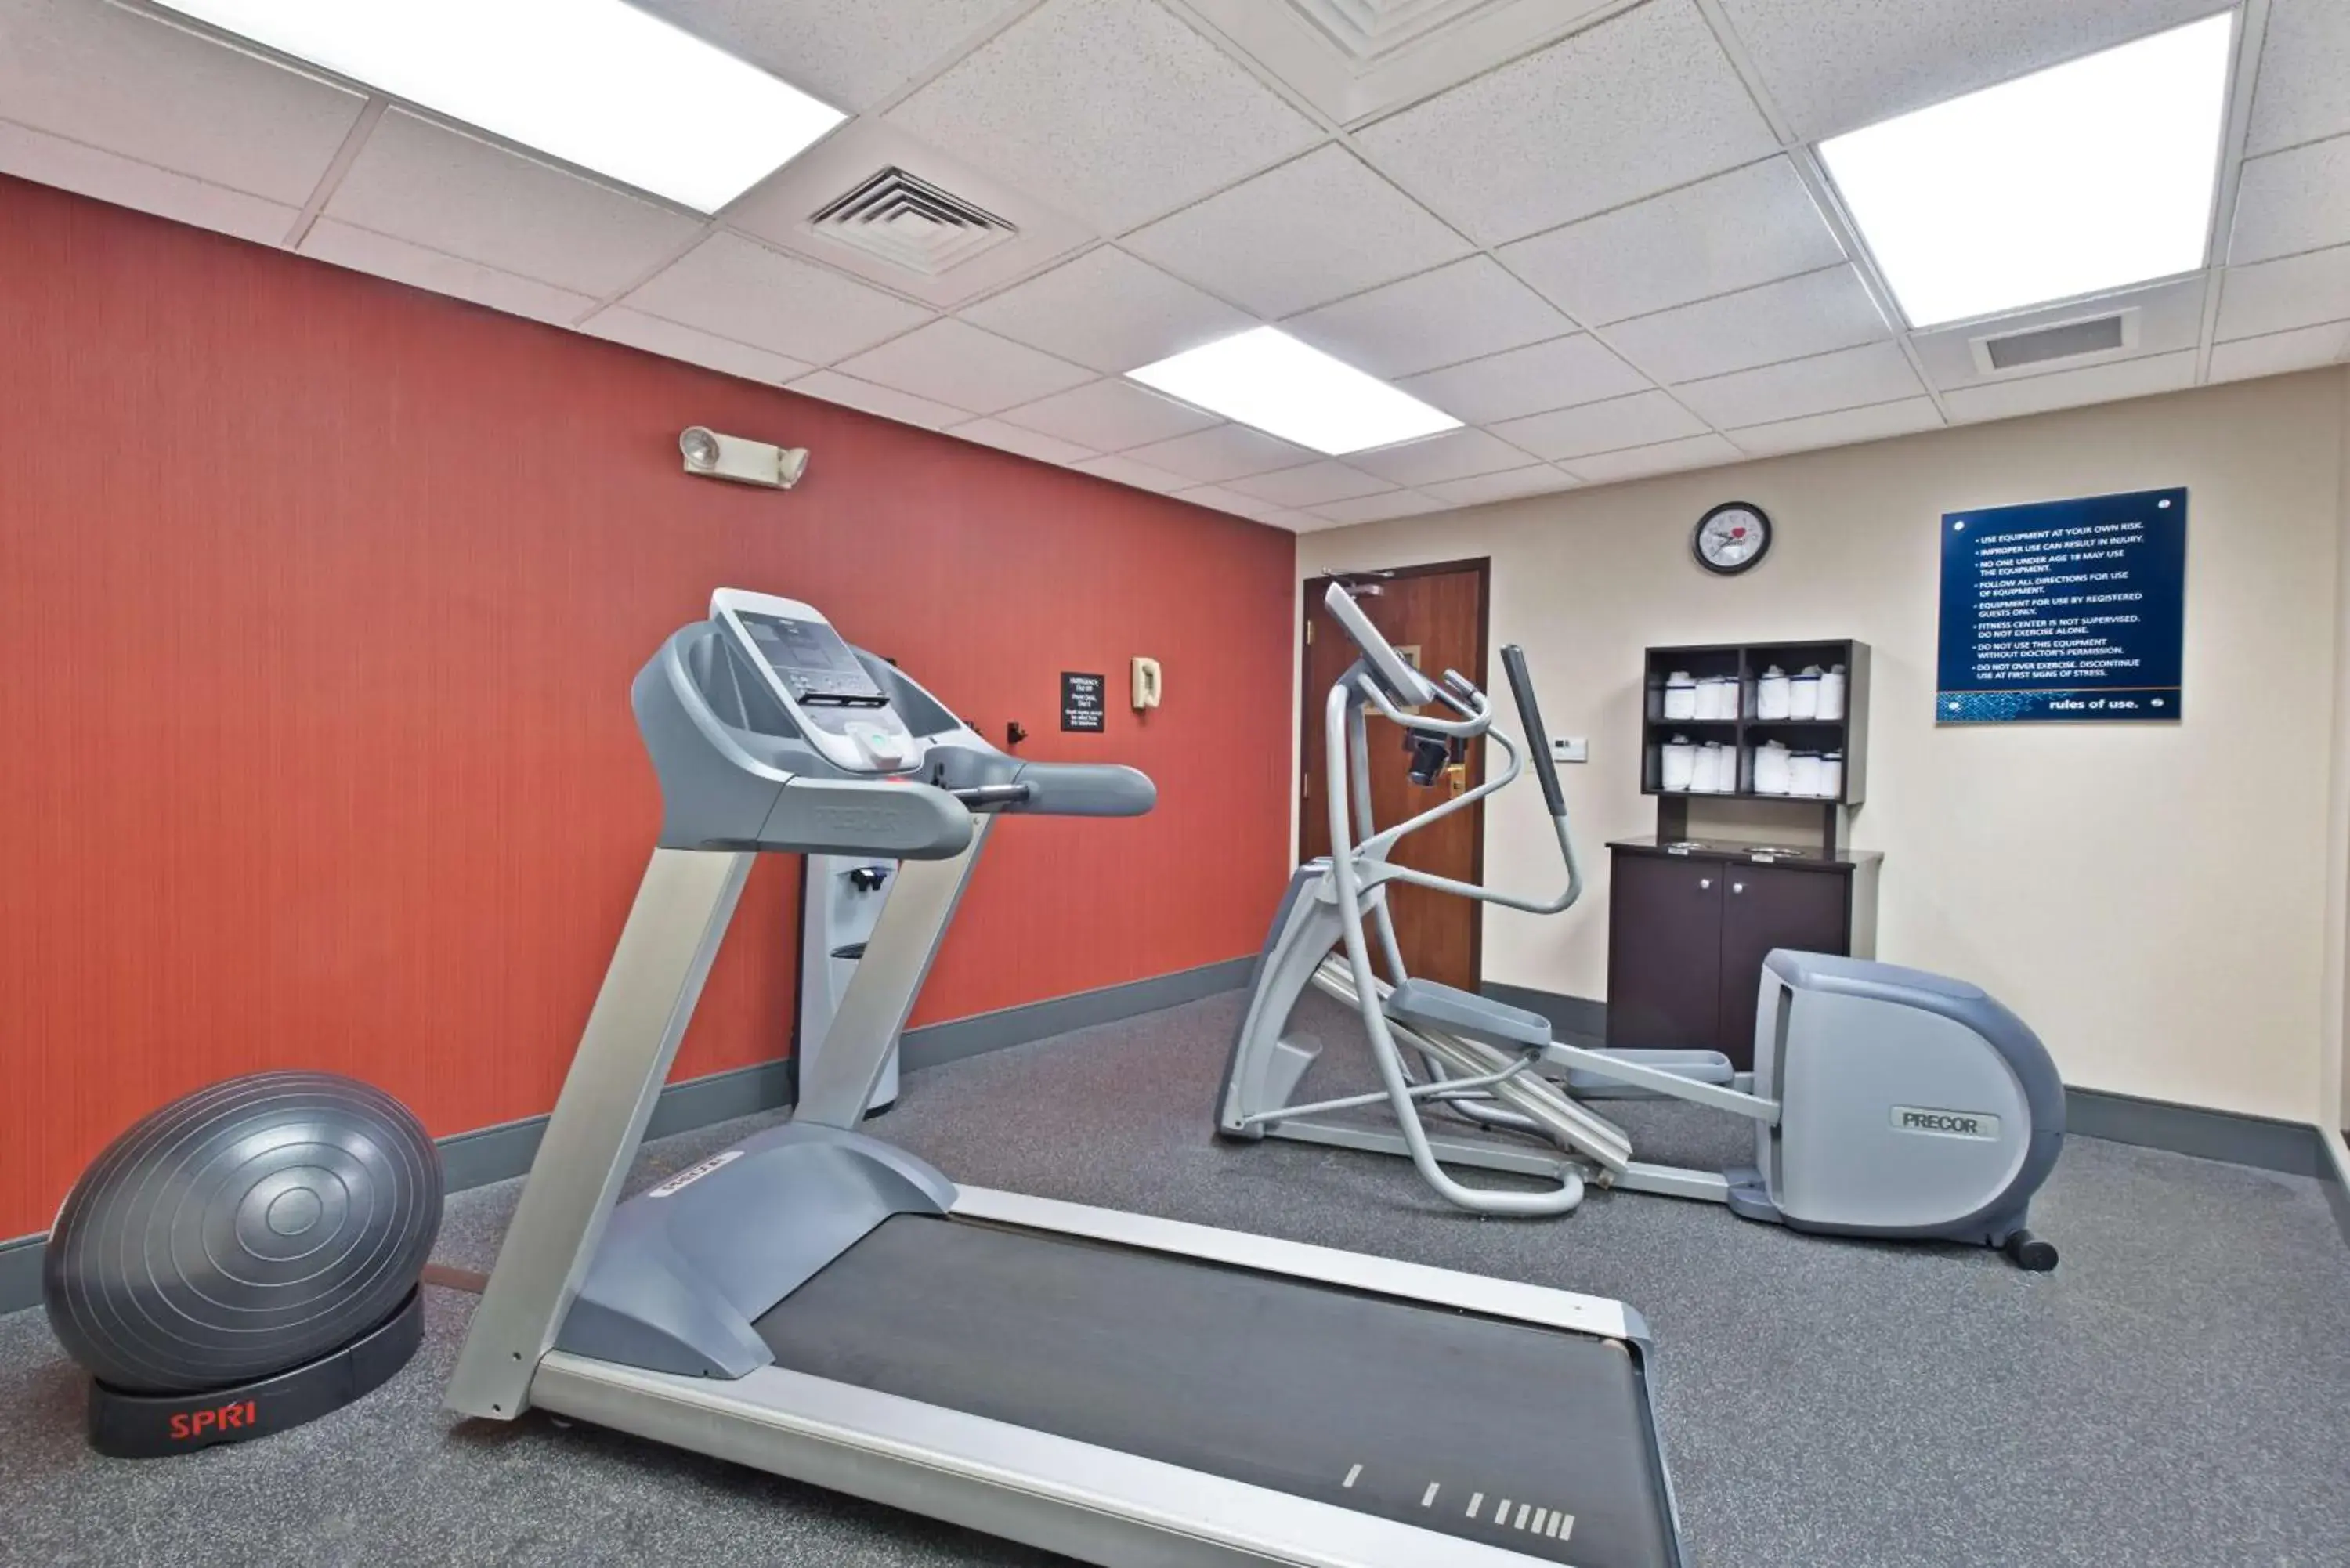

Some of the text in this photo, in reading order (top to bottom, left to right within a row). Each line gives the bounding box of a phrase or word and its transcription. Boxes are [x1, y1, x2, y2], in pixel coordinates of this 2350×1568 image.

[1998, 531, 2050, 543] EQUIPMENT
[2065, 526, 2092, 536] YOUR
[2094, 524, 2119, 533] OWN
[2064, 539, 2096, 549] RESULT
[2016, 556, 2047, 565] UNDER
[2082, 551, 2105, 560] MAY
[2106, 549, 2125, 558] USE
[1980, 568, 1997, 576] THE
[1979, 580, 2016, 589] FOLLOW
[2035, 574, 2088, 585] DIRECTIONS
[2089, 573, 2108, 582] FOR
[2110, 570, 2129, 580] USE
[1979, 599, 2030, 609] EQUIPMENT
[2086, 592, 2142, 603] REGISTERED
[2012, 620, 2047, 628] CENTER
[2053, 638, 2108, 648] EQUIPMENT
[1992, 663, 2010, 671] NOT
[2011, 662, 2035, 670] OVER
[2080, 659, 2141, 668] DISCONTINUE
[1994, 671, 2006, 680] AT
[2048, 698, 2140, 710] rules of use.
[1903, 1112, 1978, 1133] PRECOR
[170, 1400, 256, 1439] SPRI
